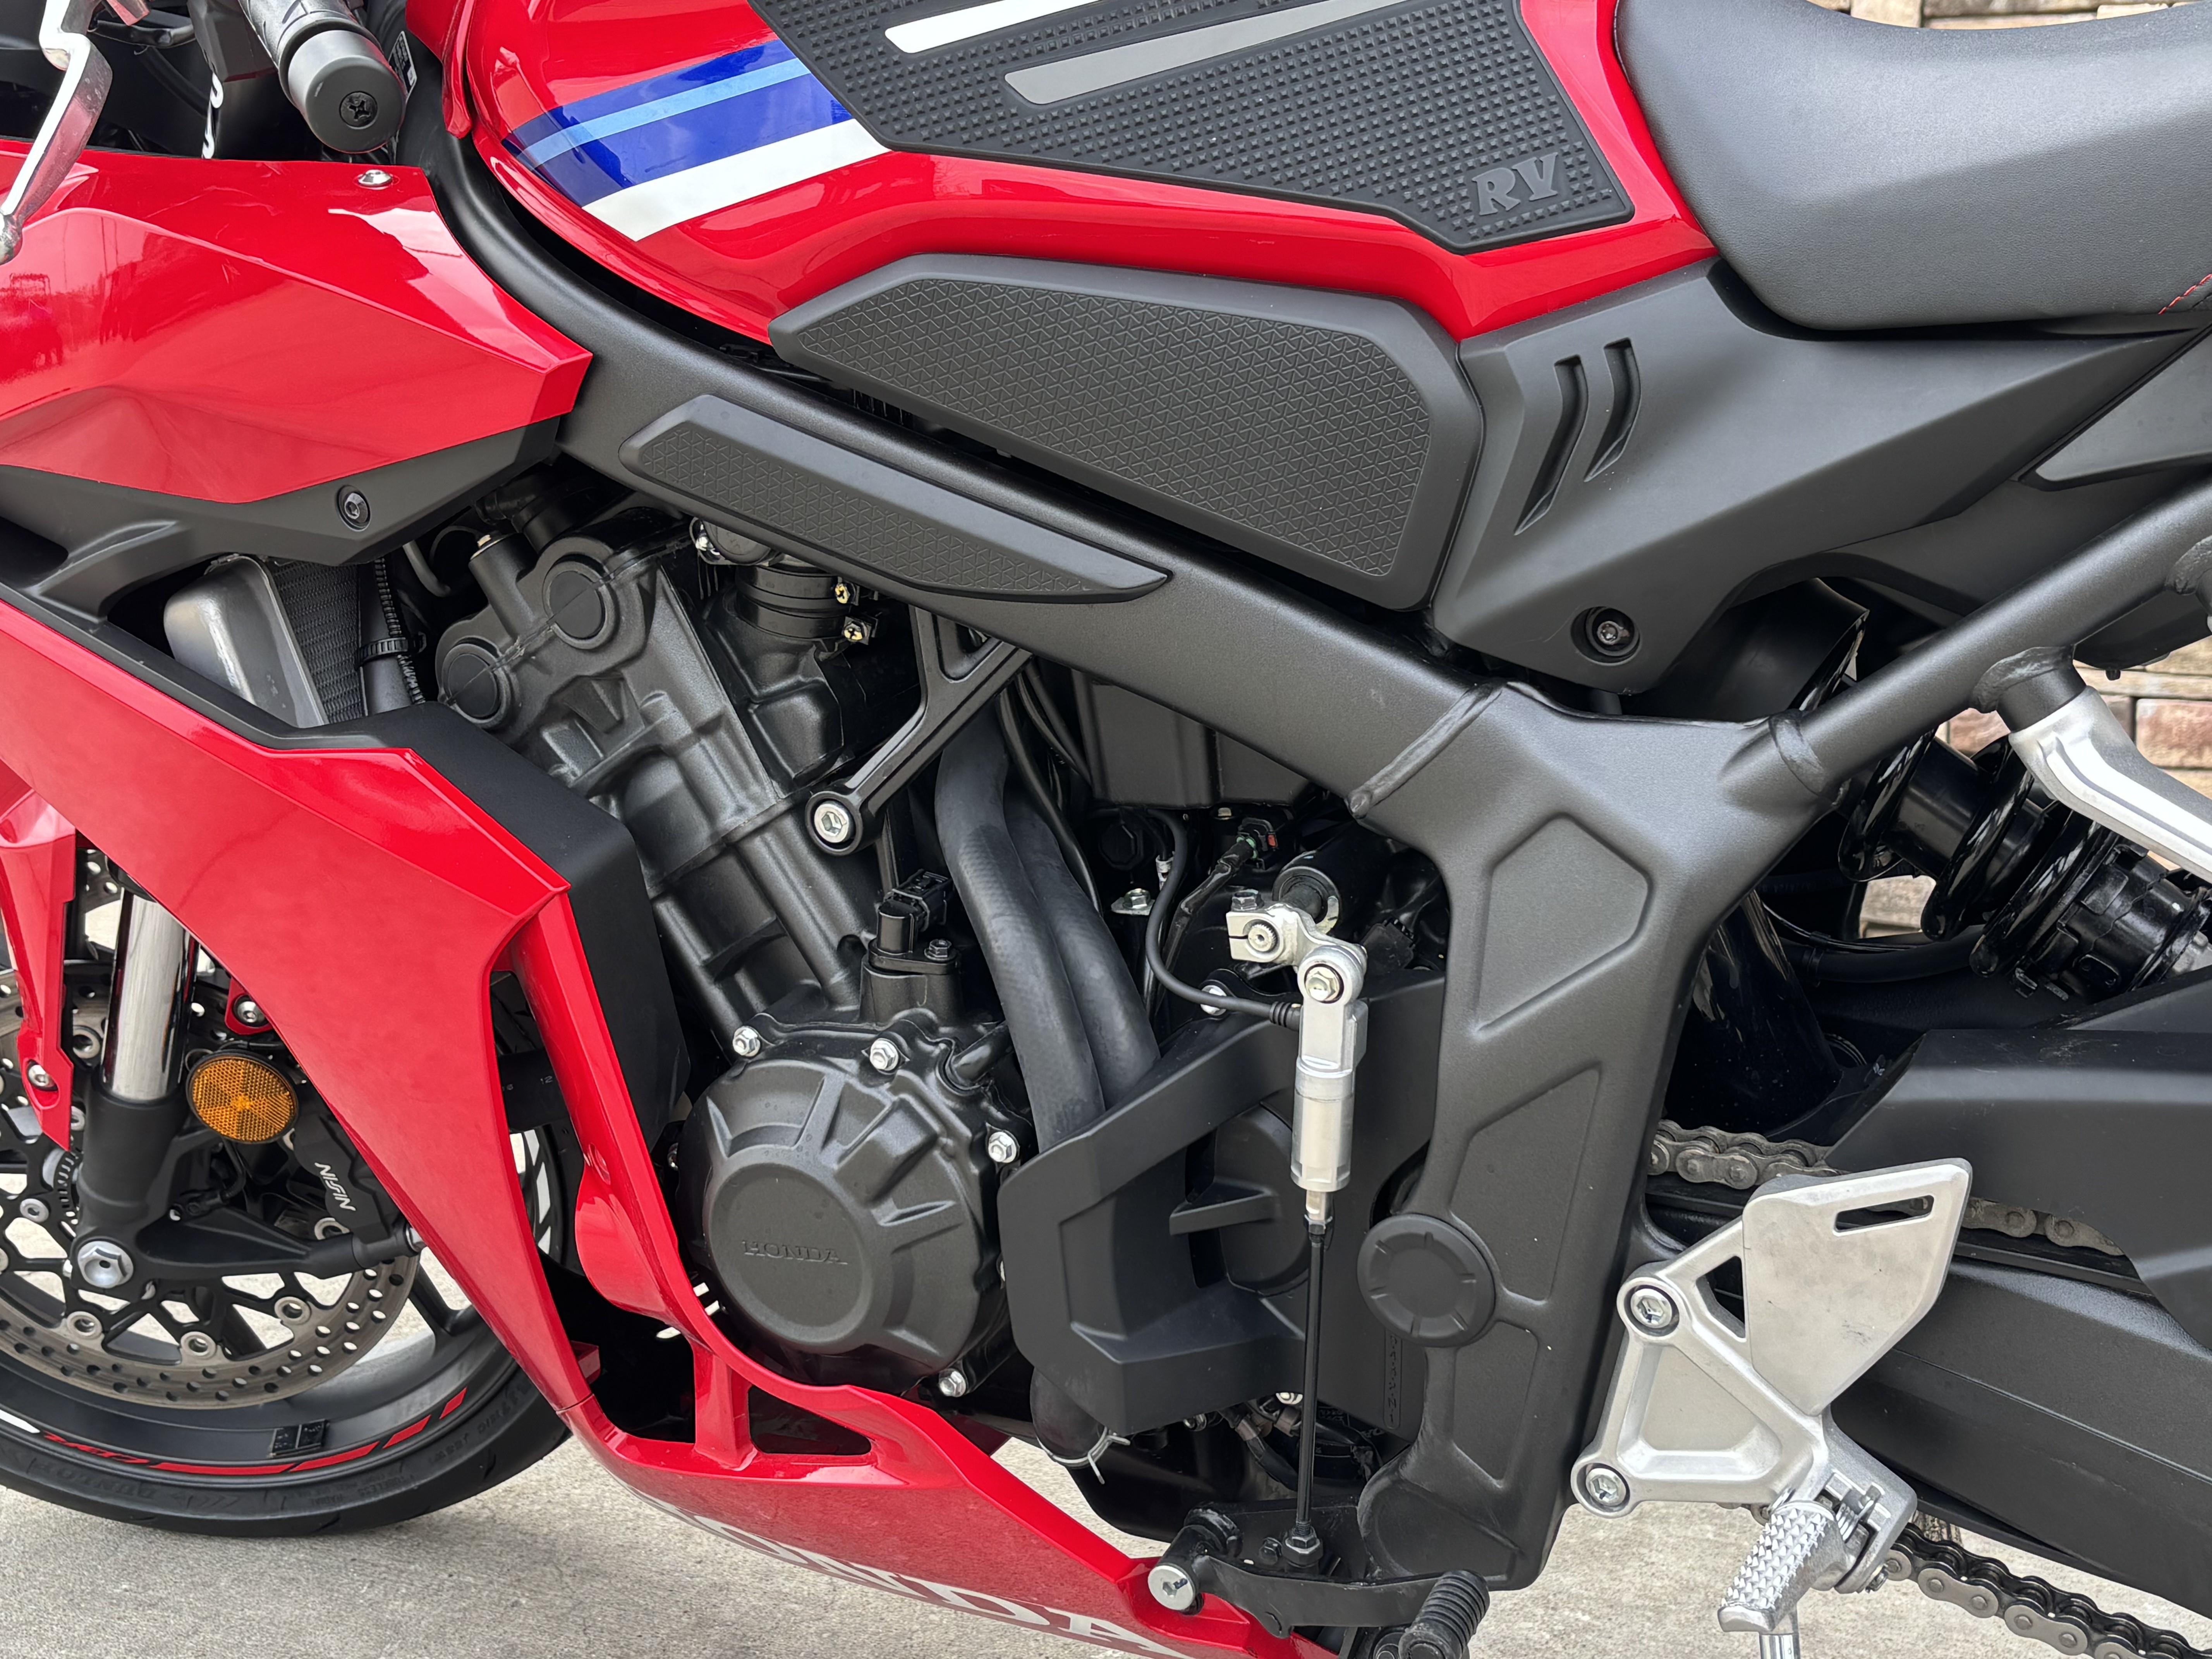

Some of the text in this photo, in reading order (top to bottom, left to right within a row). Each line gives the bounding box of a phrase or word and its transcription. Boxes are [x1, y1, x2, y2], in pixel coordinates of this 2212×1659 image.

[1472, 152, 1558, 215] RV
[314, 1162, 356, 1211] NISSIN
[742, 1239, 848, 1265] HONDA
